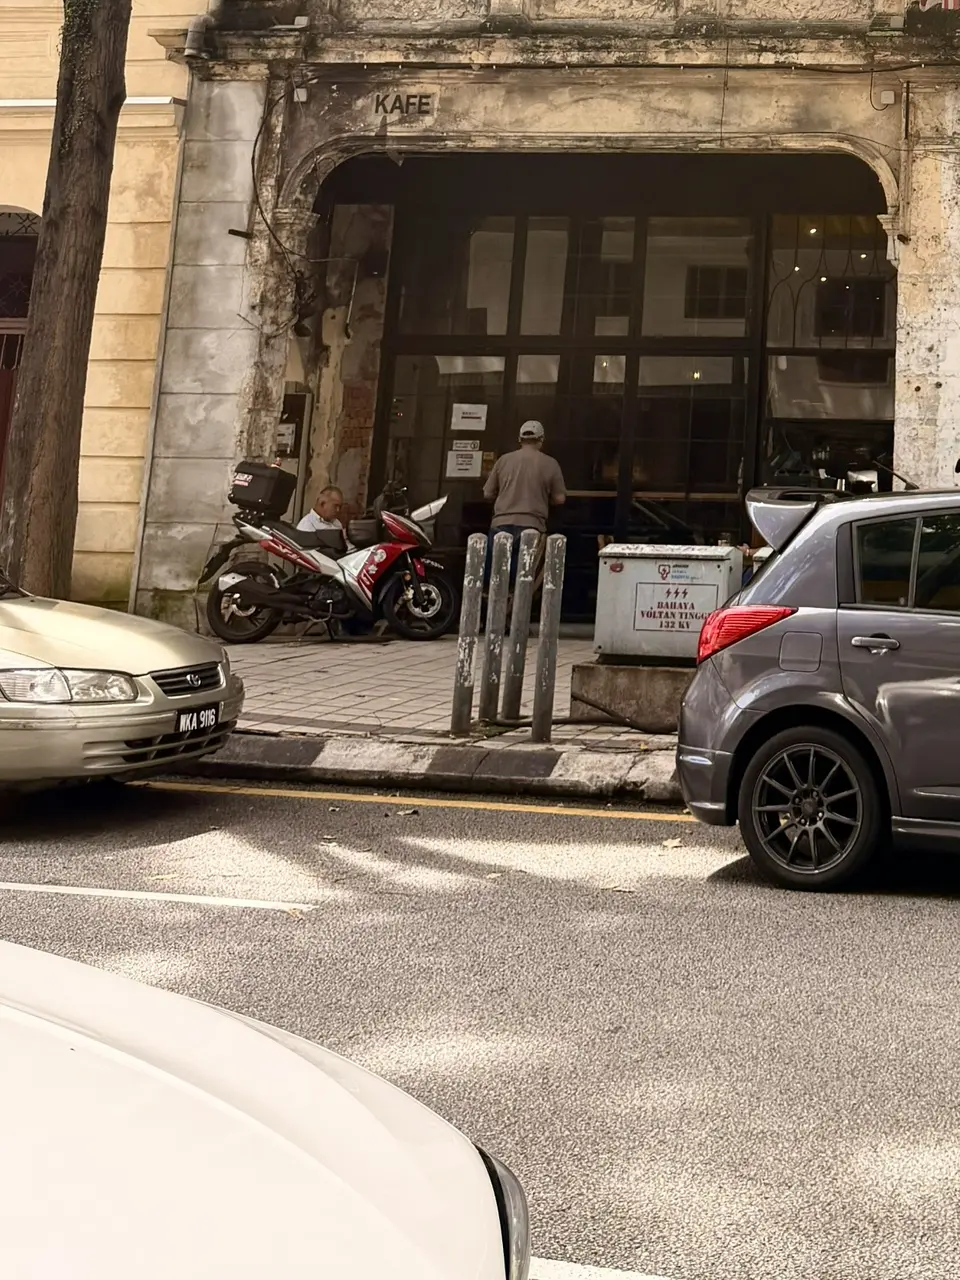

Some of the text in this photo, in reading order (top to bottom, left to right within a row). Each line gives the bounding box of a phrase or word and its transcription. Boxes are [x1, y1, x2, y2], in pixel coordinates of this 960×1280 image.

[374, 94, 431, 114] KAFE
[657, 601, 695, 610] BAHAYA
[641, 610, 676, 619] VOLTAN
[660, 620, 691, 629] 132 KV
[180, 708, 216, 732] WKA 9116
